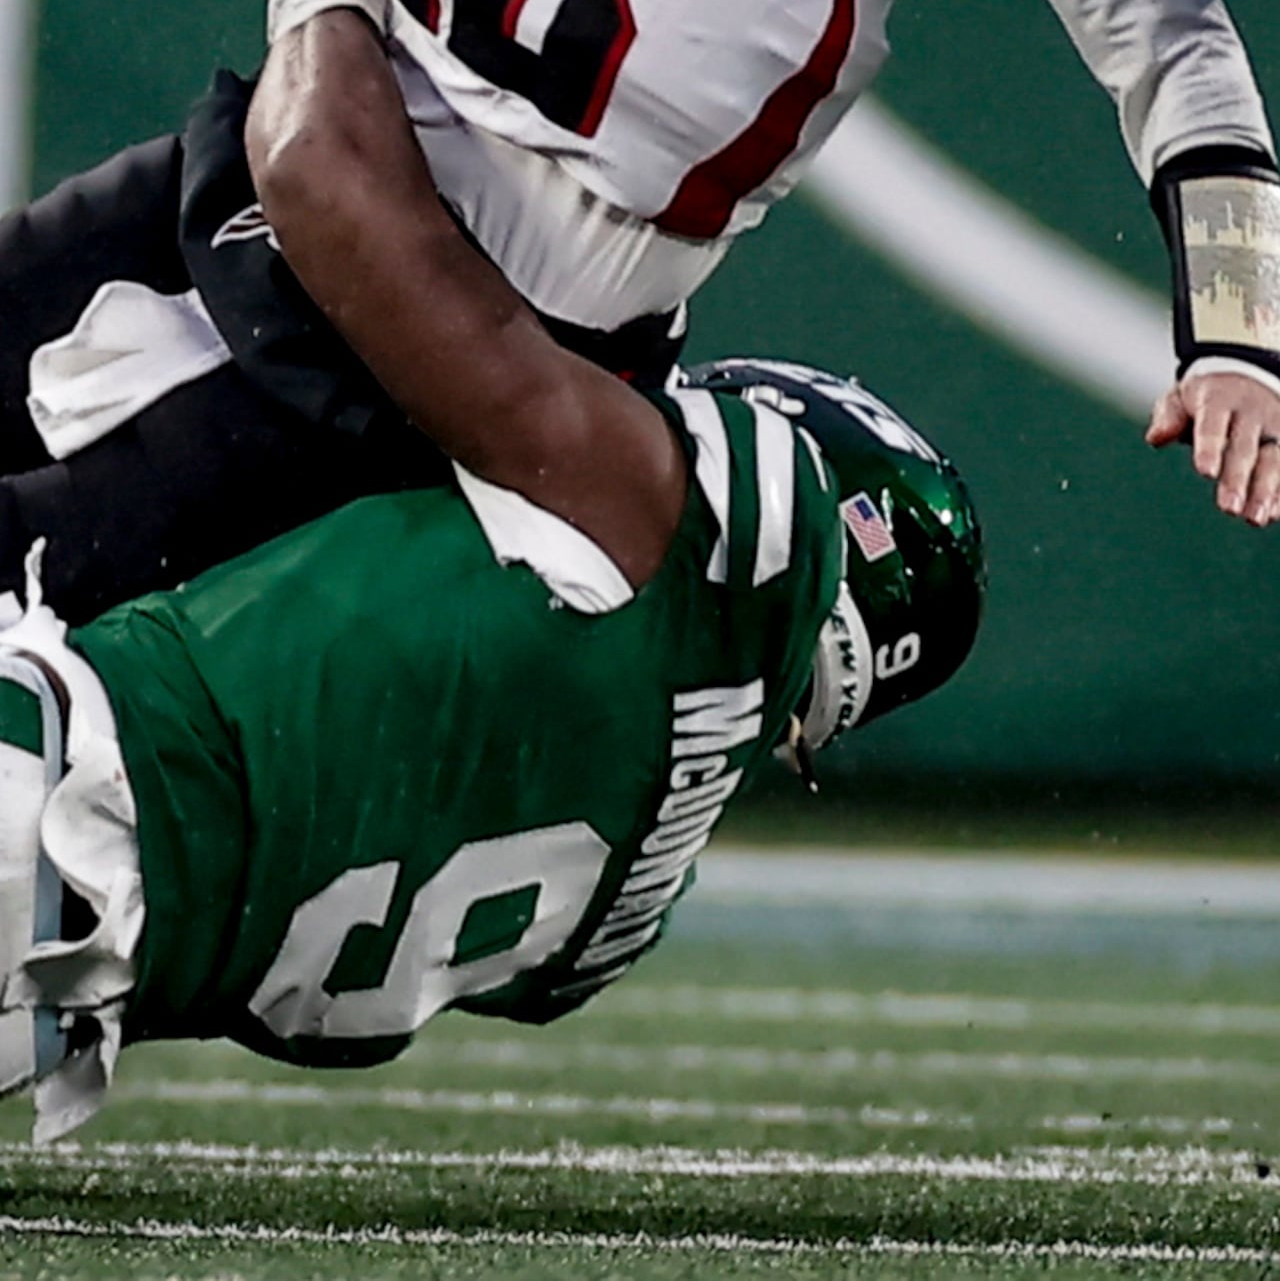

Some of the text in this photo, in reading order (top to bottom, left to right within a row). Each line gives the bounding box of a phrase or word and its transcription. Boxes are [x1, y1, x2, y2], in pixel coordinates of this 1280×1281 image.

[829, 602, 857, 672] EW
[874, 631, 922, 681] 9
[246, 819, 613, 1040] 9
